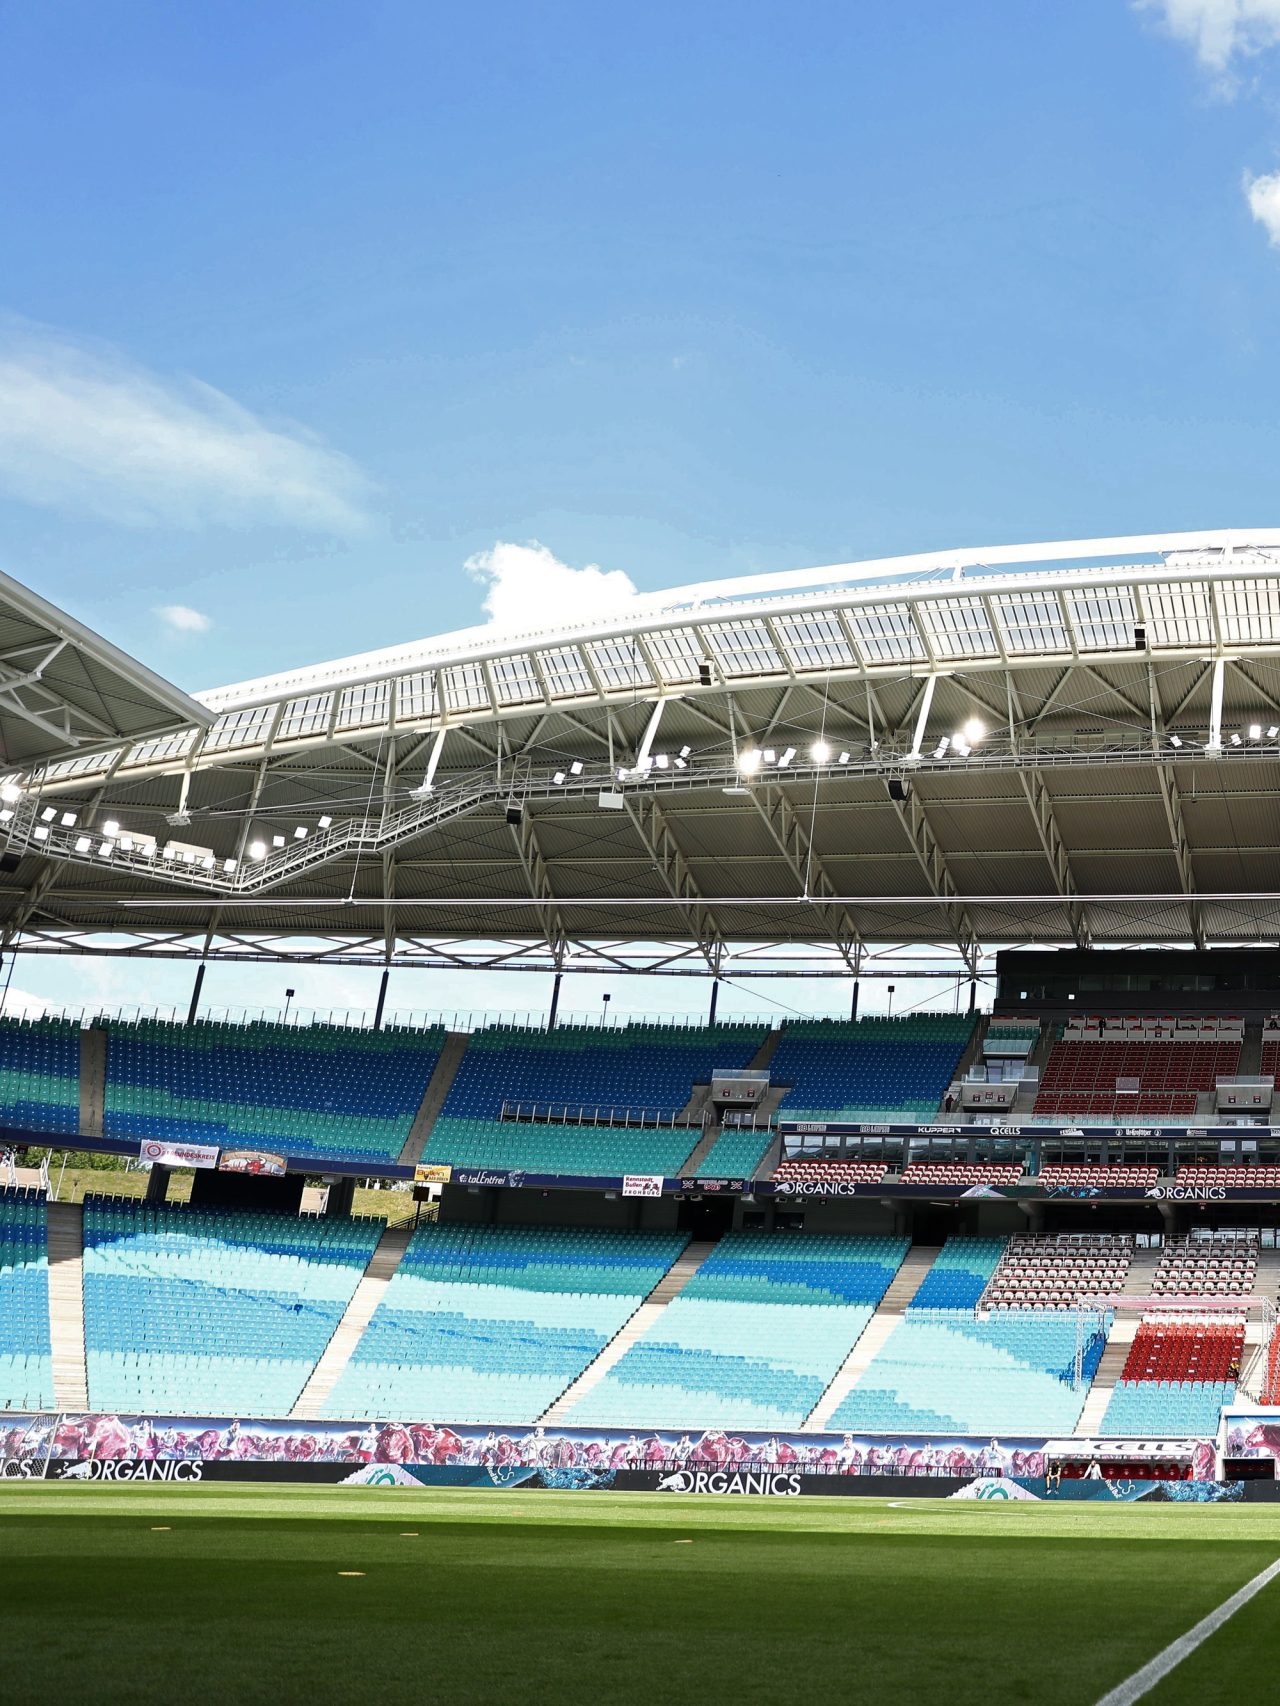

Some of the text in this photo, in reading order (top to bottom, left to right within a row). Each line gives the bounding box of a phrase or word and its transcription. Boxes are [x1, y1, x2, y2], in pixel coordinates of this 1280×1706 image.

[783, 1181, 855, 1196] ORGANICS
[1154, 1186, 1227, 1200] ORGANICS
[673, 1470, 802, 1496] ORGANICS
